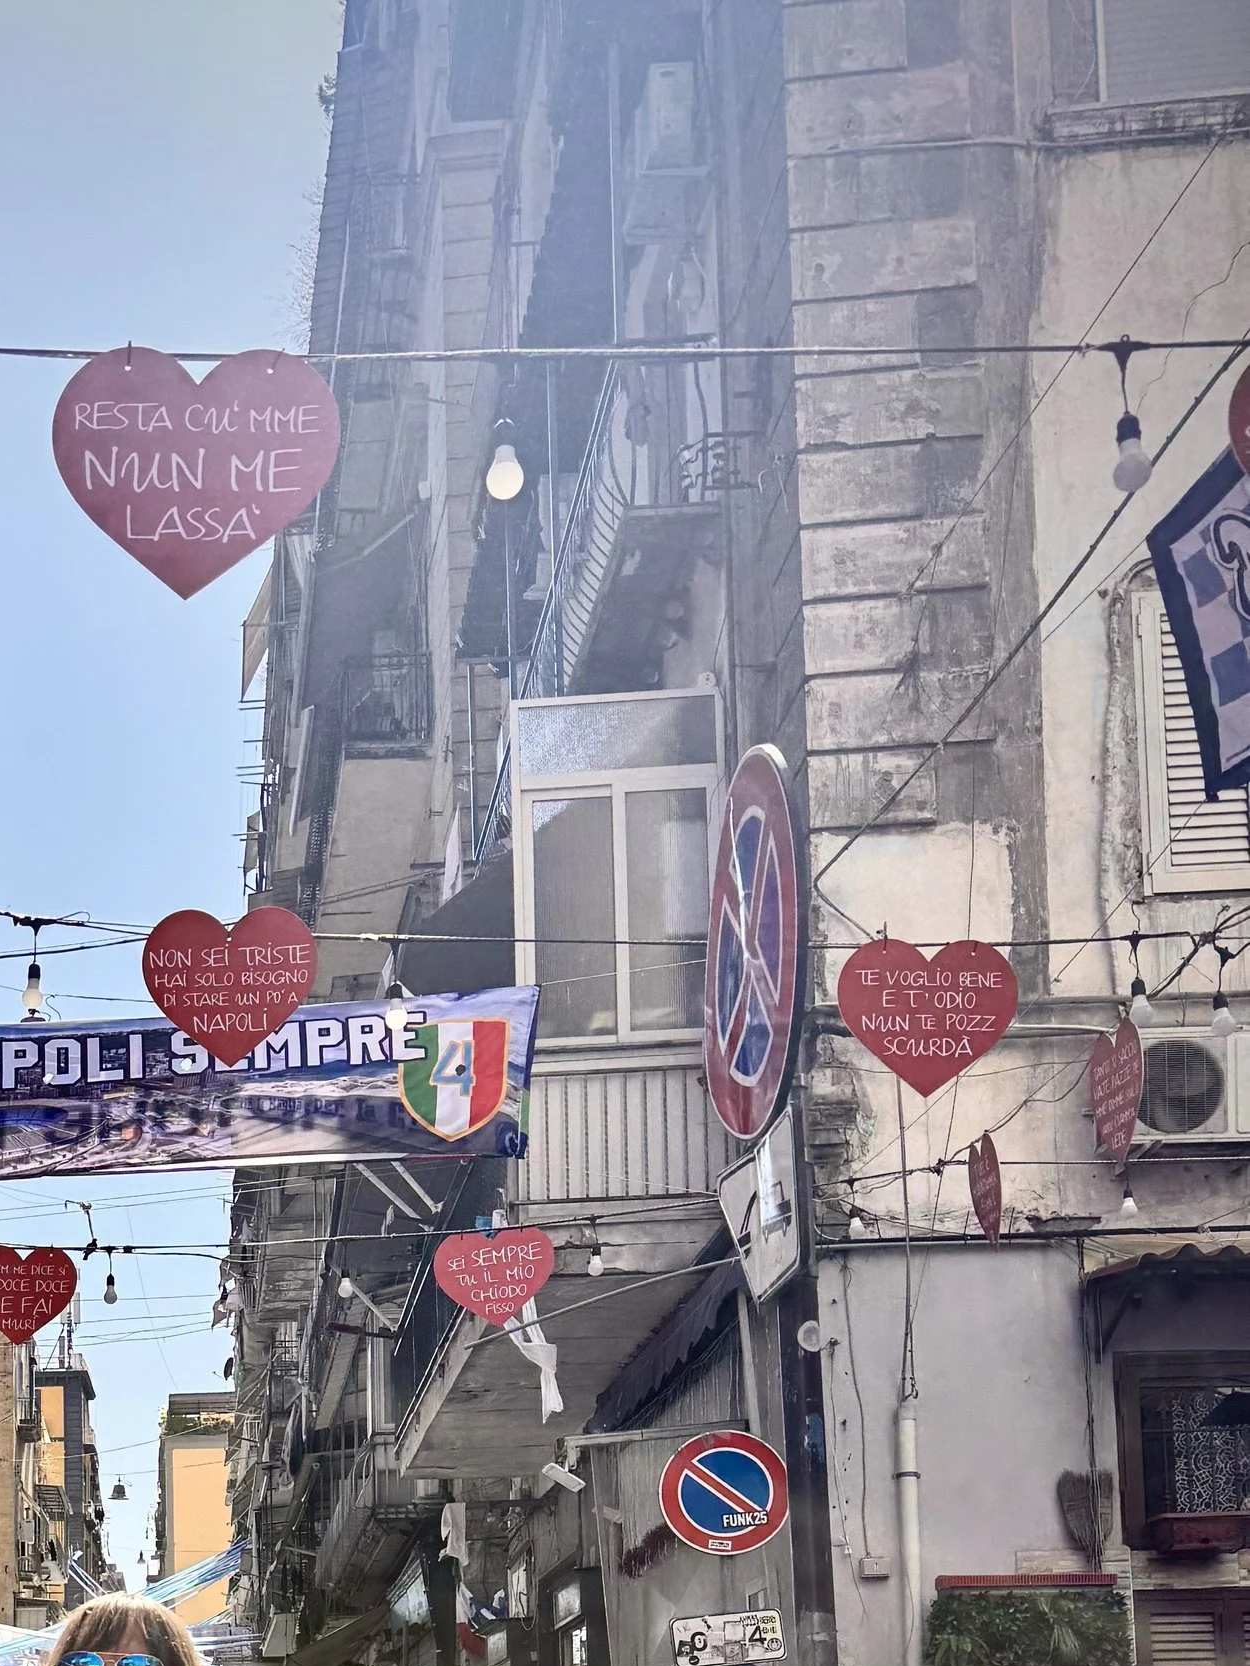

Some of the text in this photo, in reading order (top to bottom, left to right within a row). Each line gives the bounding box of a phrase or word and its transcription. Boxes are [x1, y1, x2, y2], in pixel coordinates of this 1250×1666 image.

[74, 401, 173, 433] RESTA
[84, 445, 303, 494] NUN ME
[150, 941, 311, 969] NON SEI TRISTE
[154, 968, 309, 989] HAI SOLO BISOGNO
[855, 966, 1003, 989] TE VOGLIO BENE
[163, 989, 177, 1008] DI
[182, 991, 230, 1007] STARE
[235, 990, 261, 1007] UN
[287, 991, 299, 1004] A
[882, 989, 897, 1008] E
[193, 1007, 268, 1034] NAPOLI
[861, 1012, 997, 1034] NUN TE POZZ
[429, 1040, 475, 1096] 4
[446, 1241, 543, 1272] SEI SEMPRE
[13, 1265, 28, 1276] ME
[31, 1262, 55, 1276] DICE
[505, 1262, 535, 1281] MIO
[35, 1279, 70, 1294] DOCE
[471, 1283, 528, 1302] CHIODO
[21, 1294, 54, 1316] FAI
[722, 1511, 769, 1528] FUNK25
